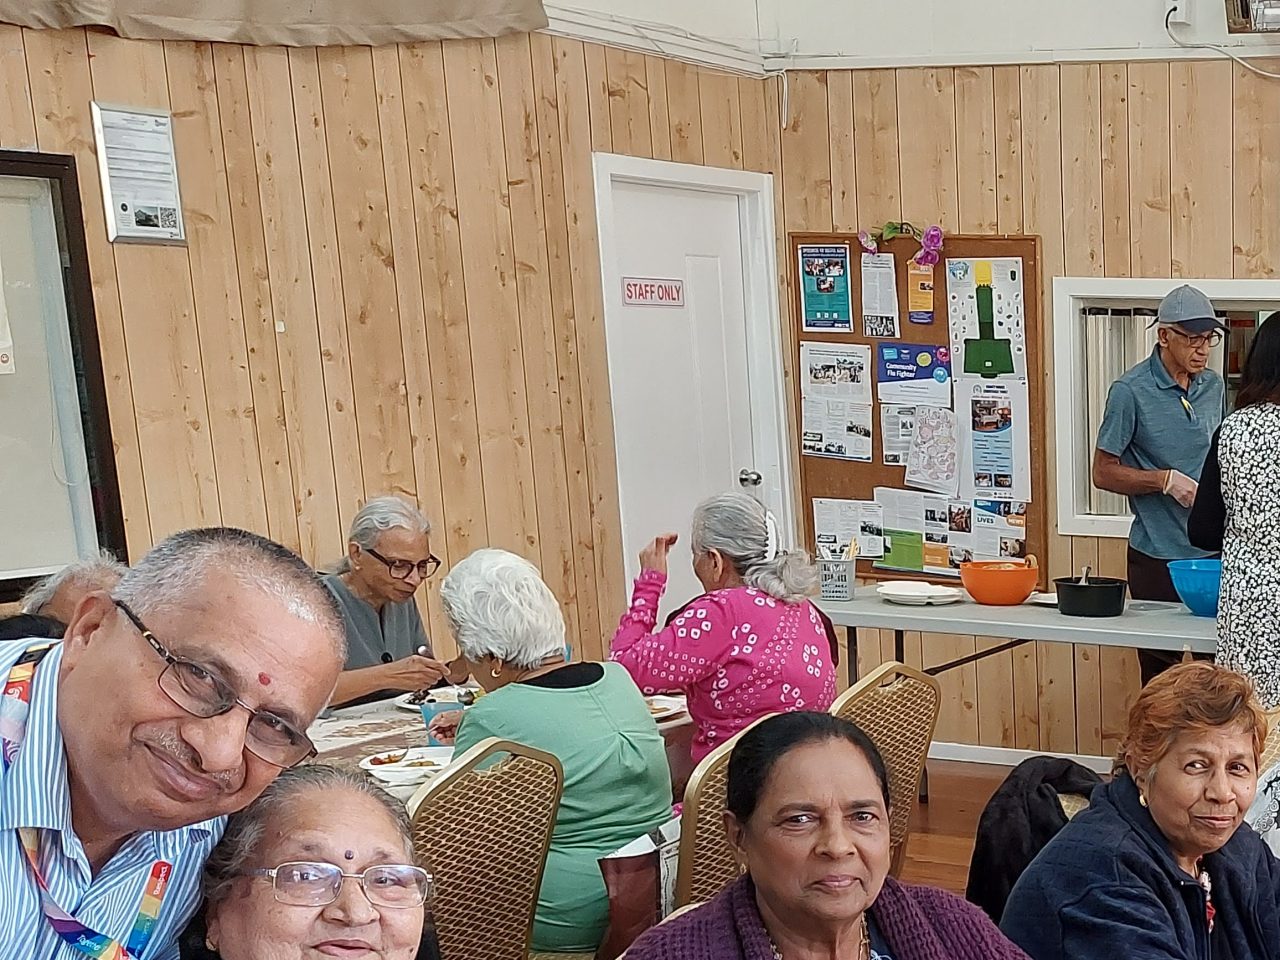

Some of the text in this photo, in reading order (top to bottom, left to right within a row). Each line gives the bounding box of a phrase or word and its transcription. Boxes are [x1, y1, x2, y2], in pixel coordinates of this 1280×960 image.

[626, 282, 681, 301] STAFF ONLY
[886, 362, 917, 372] Community
[896, 370, 916, 378] Fighter
[976, 516, 994, 524] LIVES
